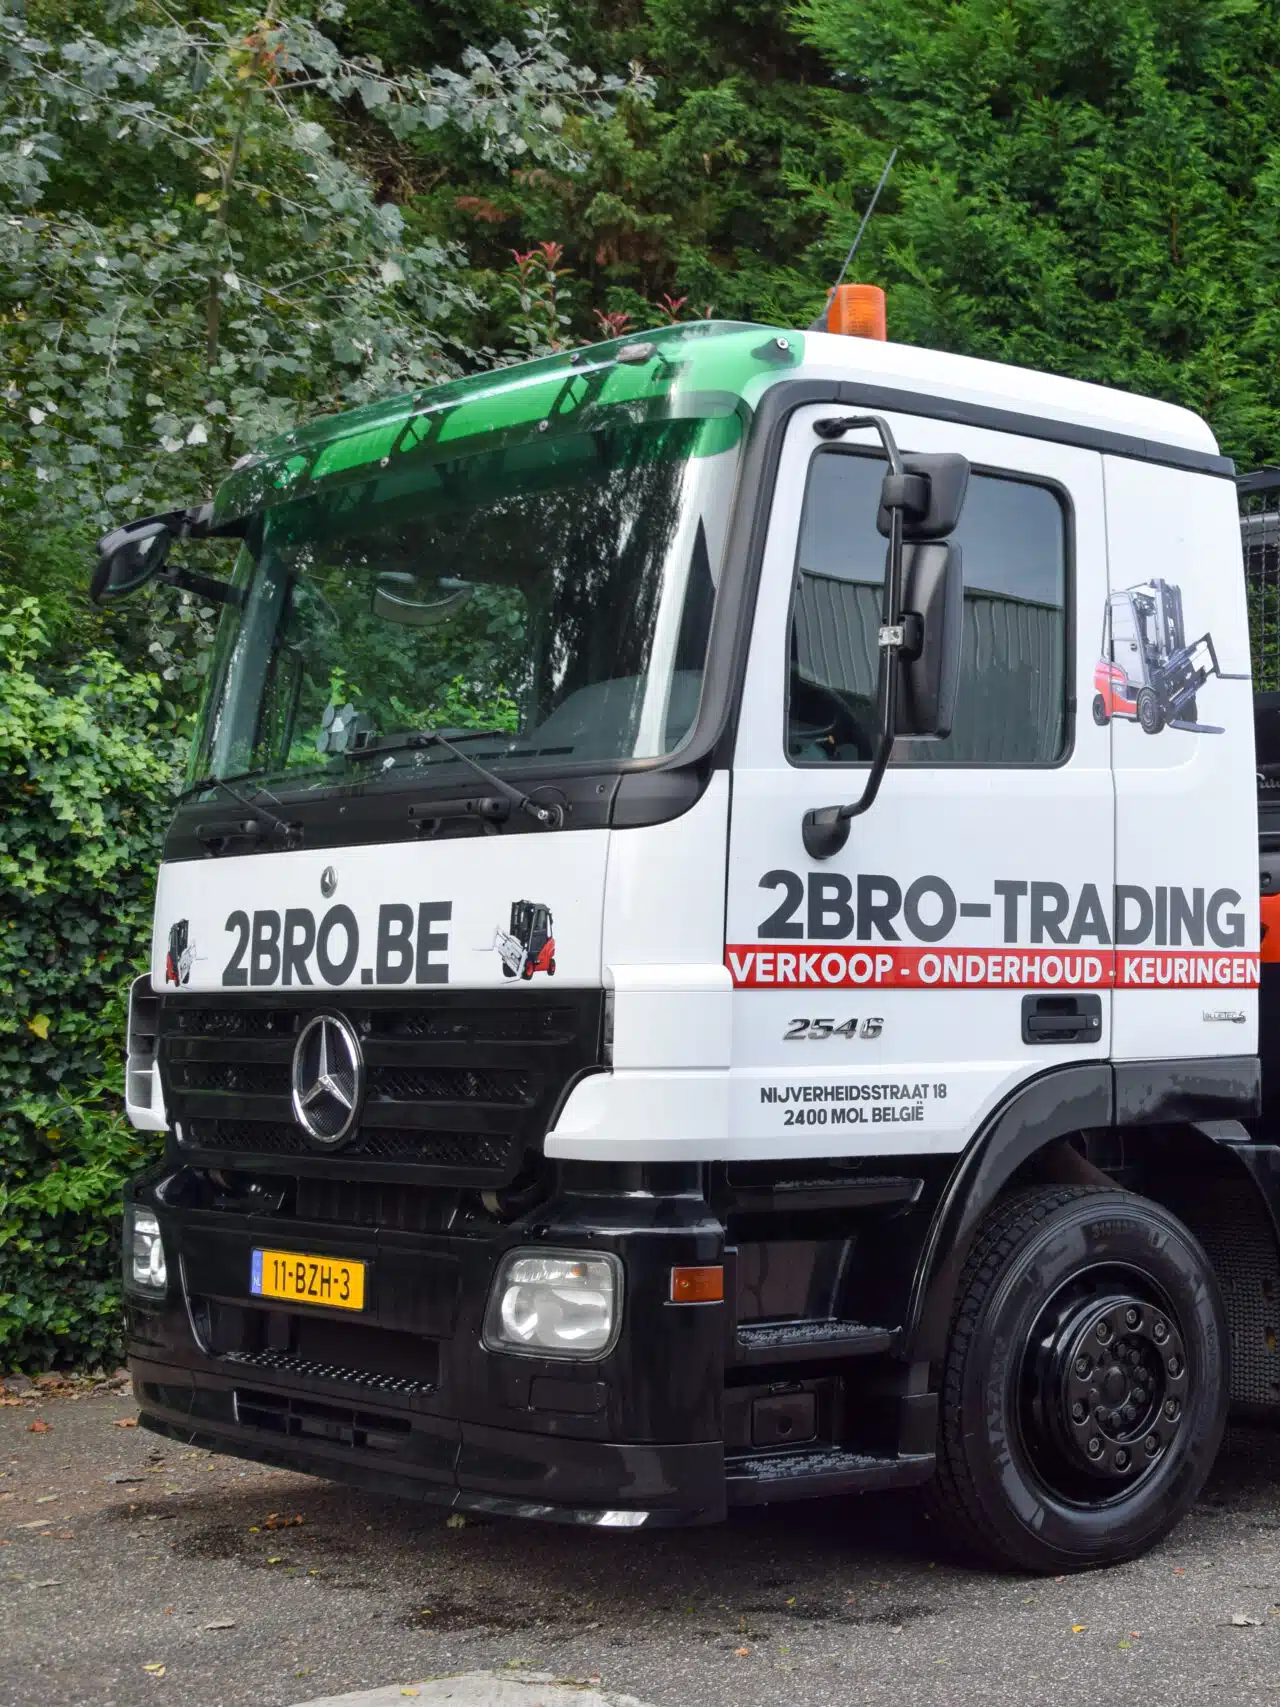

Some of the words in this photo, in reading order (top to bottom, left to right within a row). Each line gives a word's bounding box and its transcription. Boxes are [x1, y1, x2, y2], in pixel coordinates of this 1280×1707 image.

[757, 869, 1245, 948] 2BRO-TRADING
[222, 900, 453, 986] 2BRO.BE
[728, 952, 894, 983] VERKOOP
[917, 953, 1103, 985] ONDERHOUD
[1124, 957, 1261, 985] KEURINGEN
[783, 1017, 884, 1040] 2546
[760, 1084, 930, 1104] NIJVERHEIDSSTRAAT
[932, 1083, 947, 1099] 18
[783, 1108, 828, 1126] 2400
[831, 1107, 869, 1125] MOL
[871, 1101, 924, 1123] BELGIË
[253, 1275, 263, 1288] NL
[273, 1259, 351, 1301] 11-BZH-3
